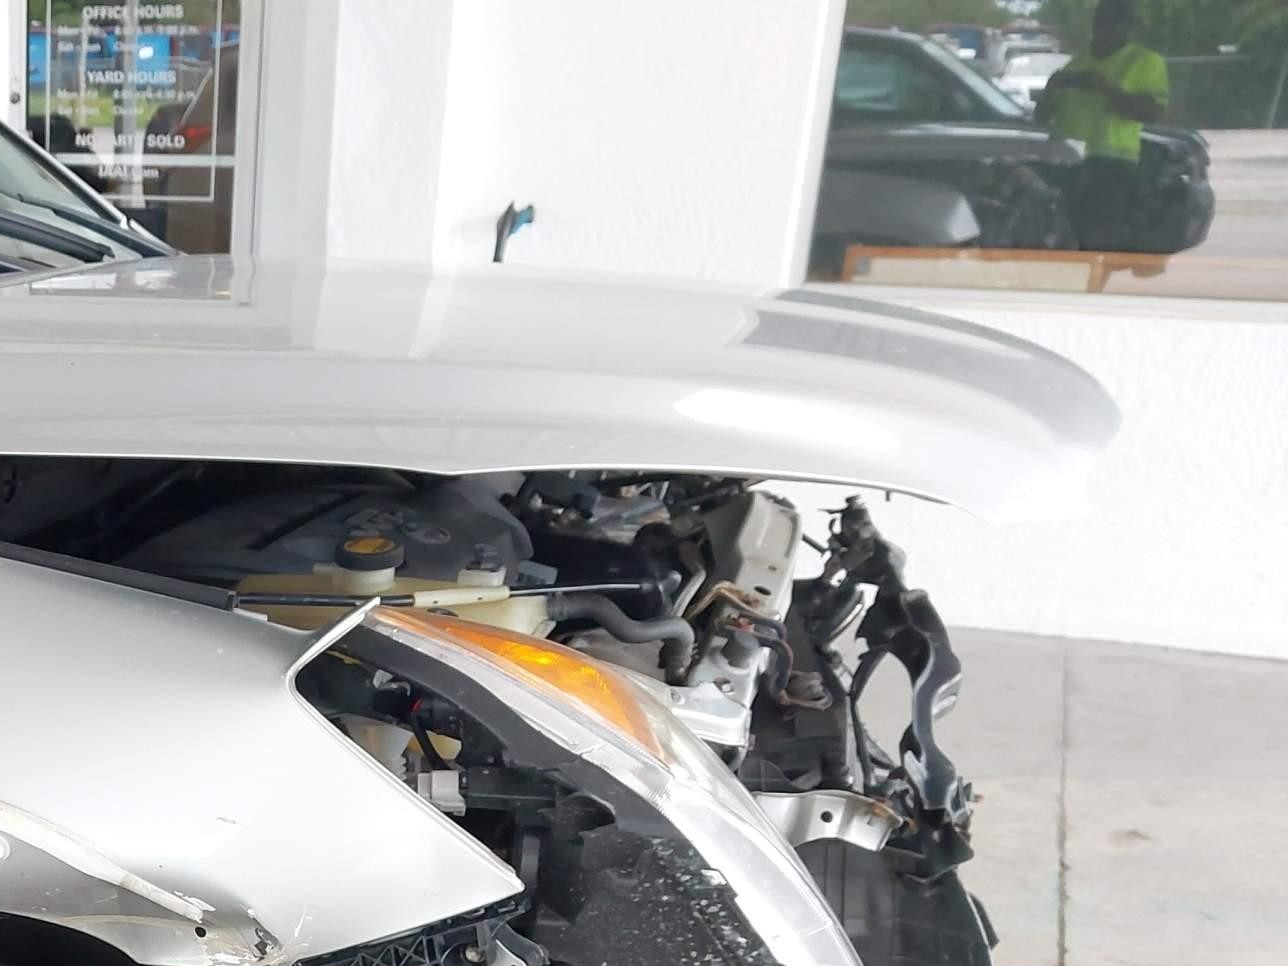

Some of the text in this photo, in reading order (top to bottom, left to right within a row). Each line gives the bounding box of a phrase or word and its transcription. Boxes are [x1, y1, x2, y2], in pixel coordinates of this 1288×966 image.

[135, 4, 185, 19] HOURS
[87, 70, 177, 84] YARD HOURS
[147, 133, 186, 148] SOLD
